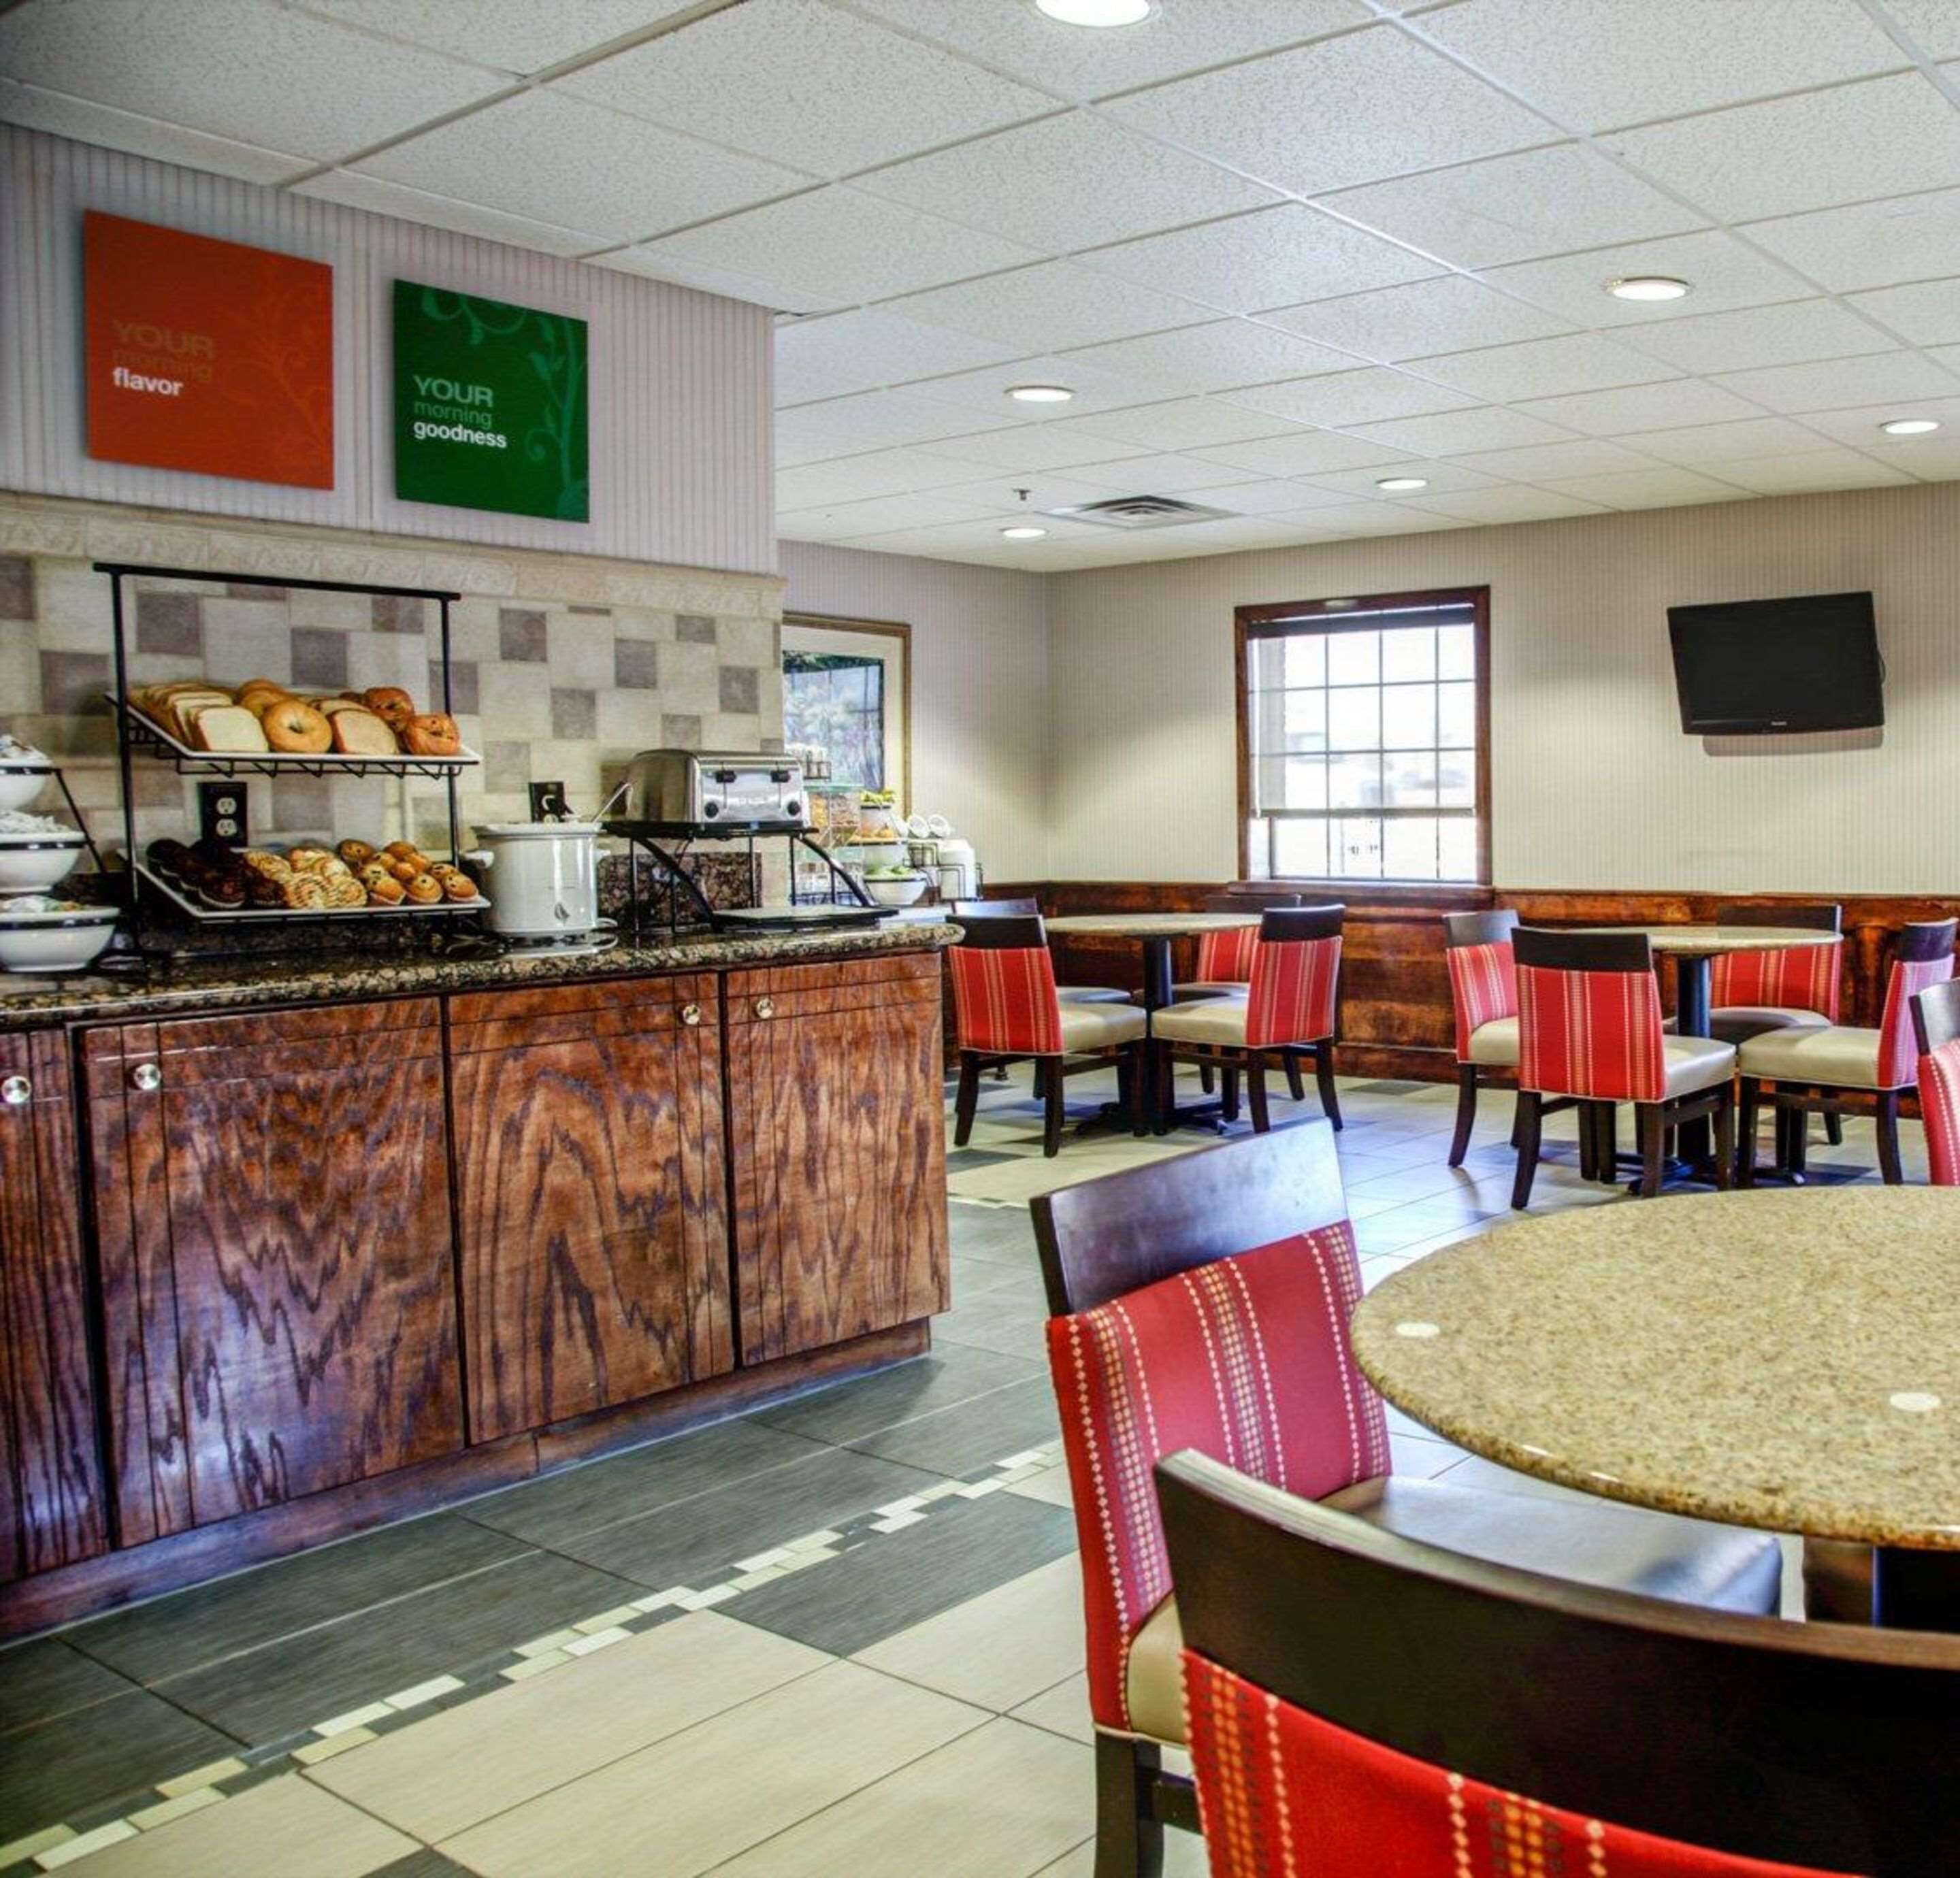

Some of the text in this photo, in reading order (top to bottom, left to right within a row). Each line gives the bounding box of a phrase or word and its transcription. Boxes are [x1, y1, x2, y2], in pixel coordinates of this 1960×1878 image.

[112, 321, 214, 358] YOUR
[113, 348, 212, 382] morning
[112, 367, 184, 396] flavor
[413, 375, 493, 408] YOUR
[414, 401, 492, 430] morning
[414, 421, 507, 448] goodness
